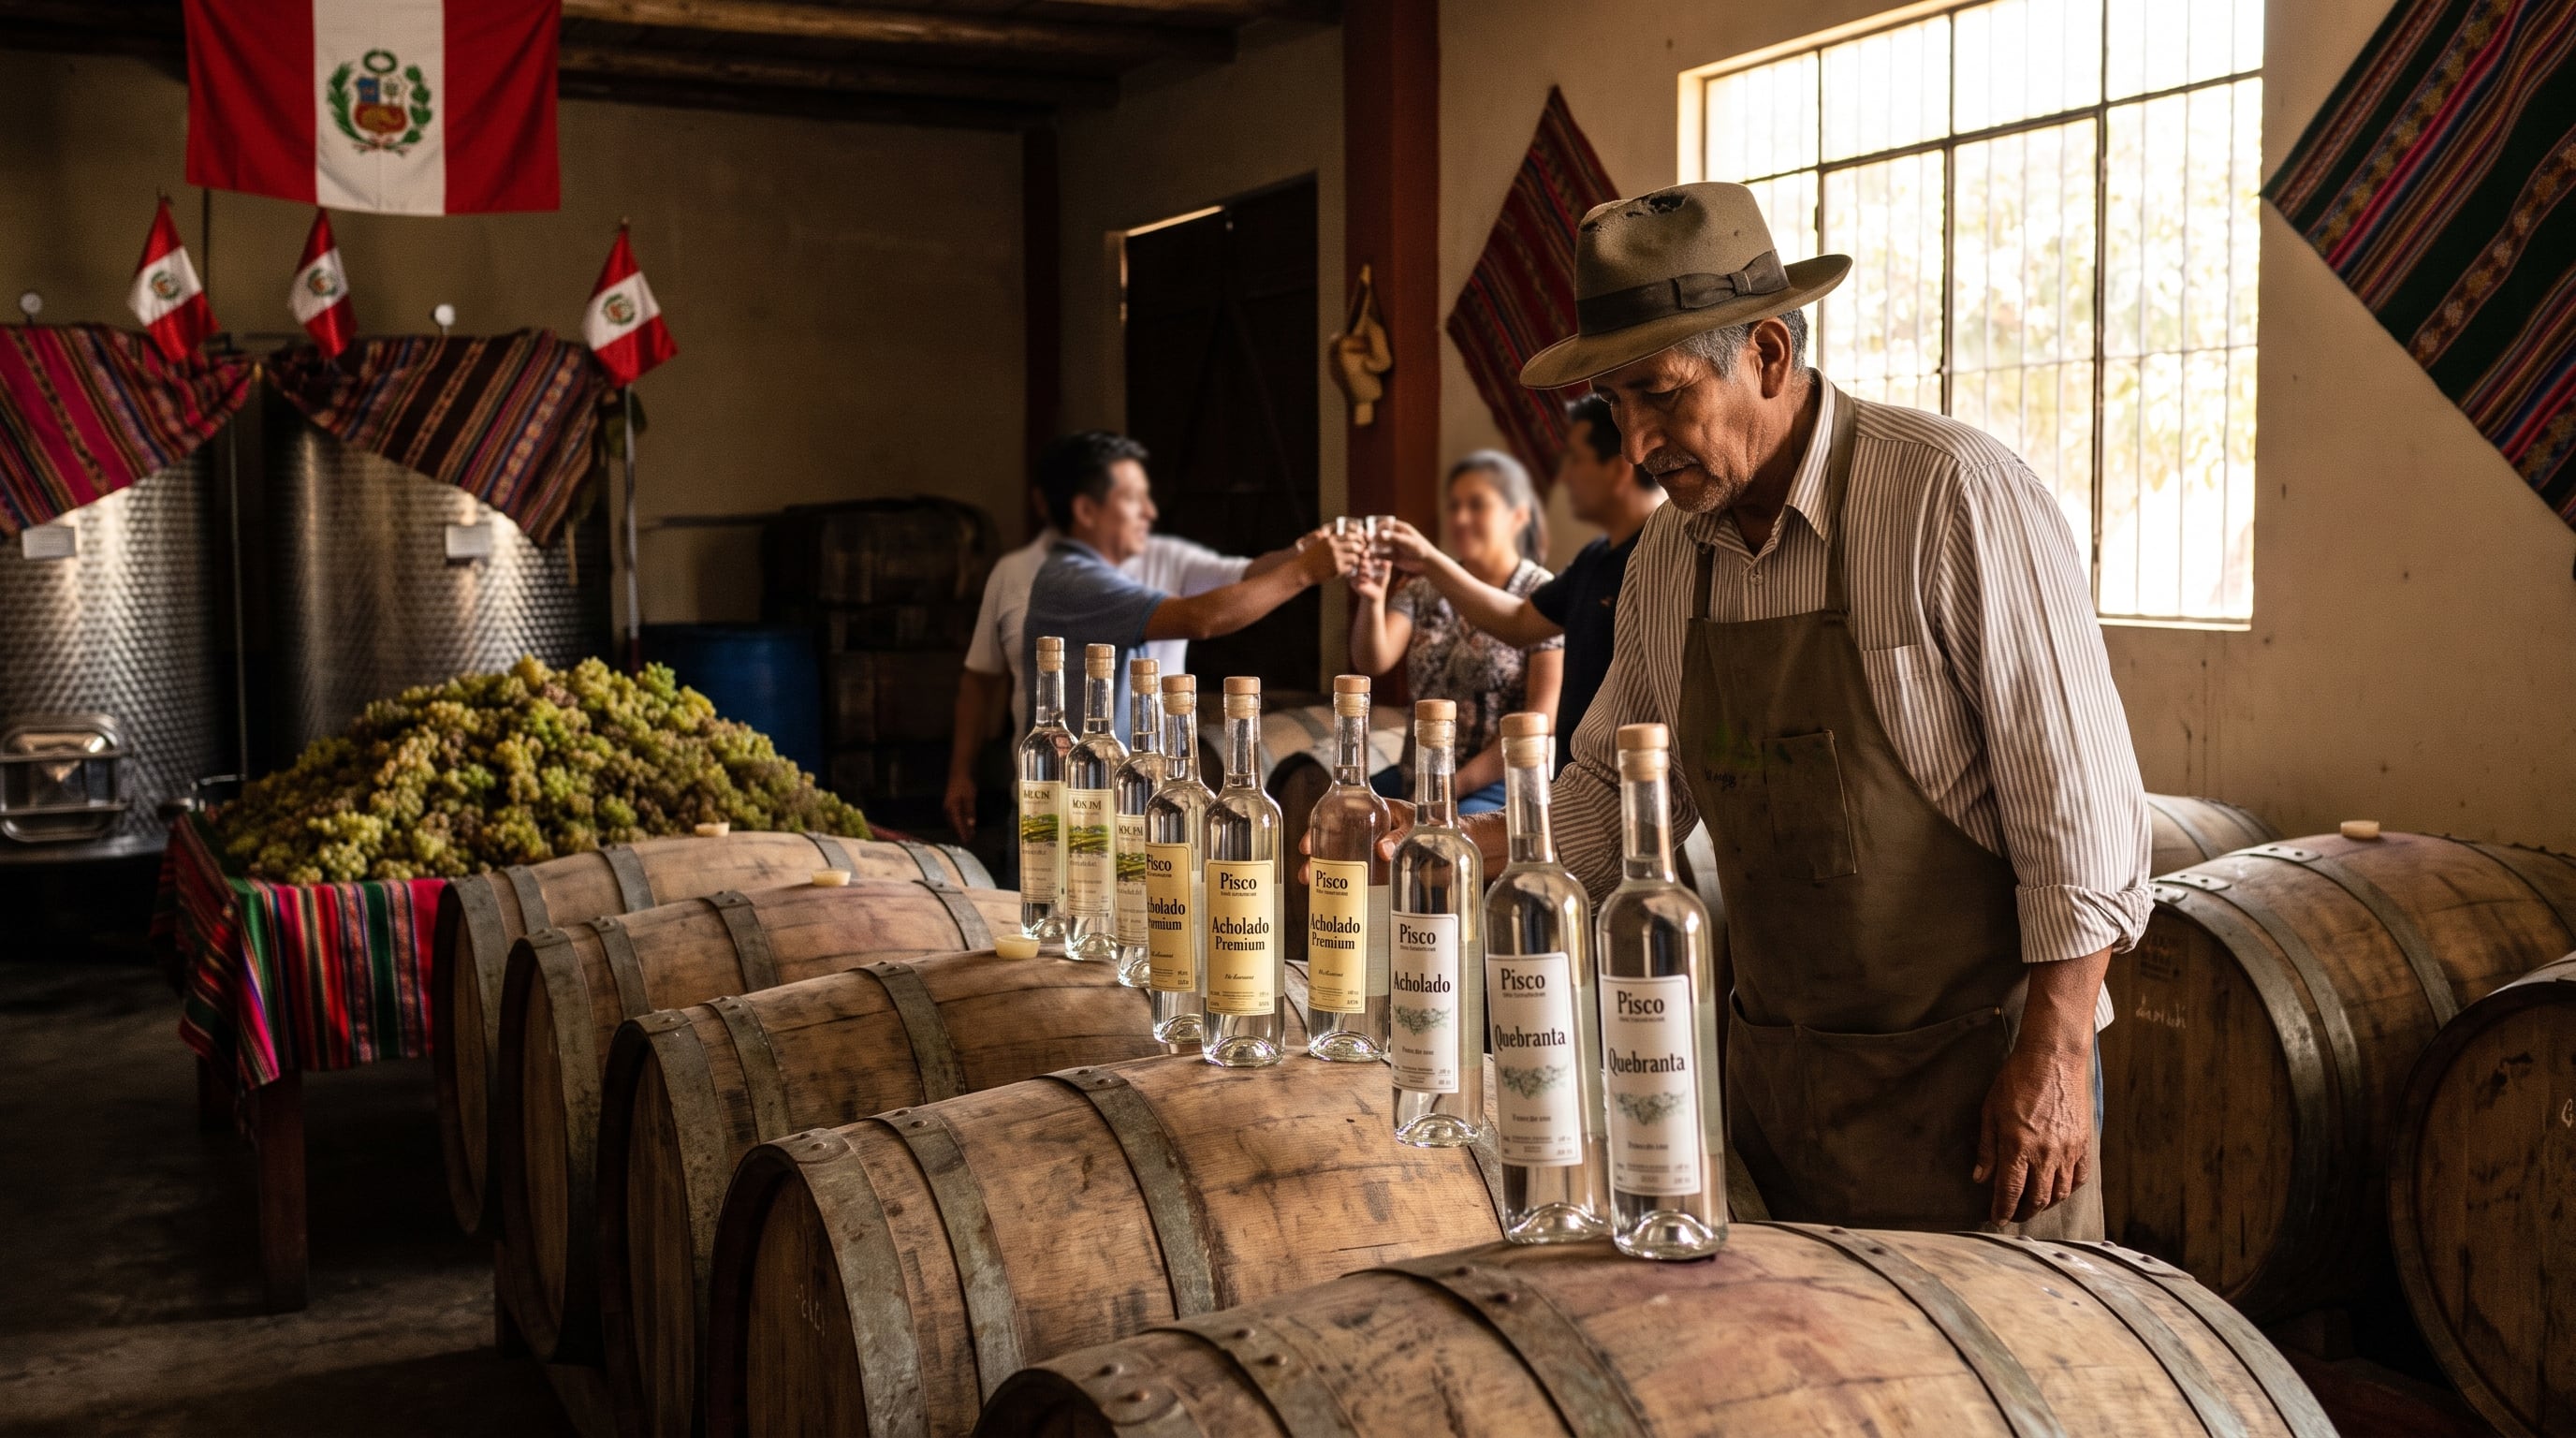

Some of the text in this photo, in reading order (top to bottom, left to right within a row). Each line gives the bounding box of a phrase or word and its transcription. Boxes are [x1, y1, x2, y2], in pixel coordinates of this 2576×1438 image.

[1220, 872, 1257, 890] Pisco
[1316, 870, 1348, 889] Pisco
[1211, 916, 1269, 935] Acholado
[1310, 913, 1360, 933] Acholado
[1215, 936, 1266, 951] Premium
[1311, 932, 1355, 950] Premium
[1399, 923, 1436, 945] Pisco
[1393, 970, 1451, 993] Acholado
[1500, 967, 1545, 990] Pisco
[1617, 990, 1664, 1015] Pisco
[1495, 1024, 1566, 1051] Quebranta
[1608, 1048, 1685, 1077] Quebranta
